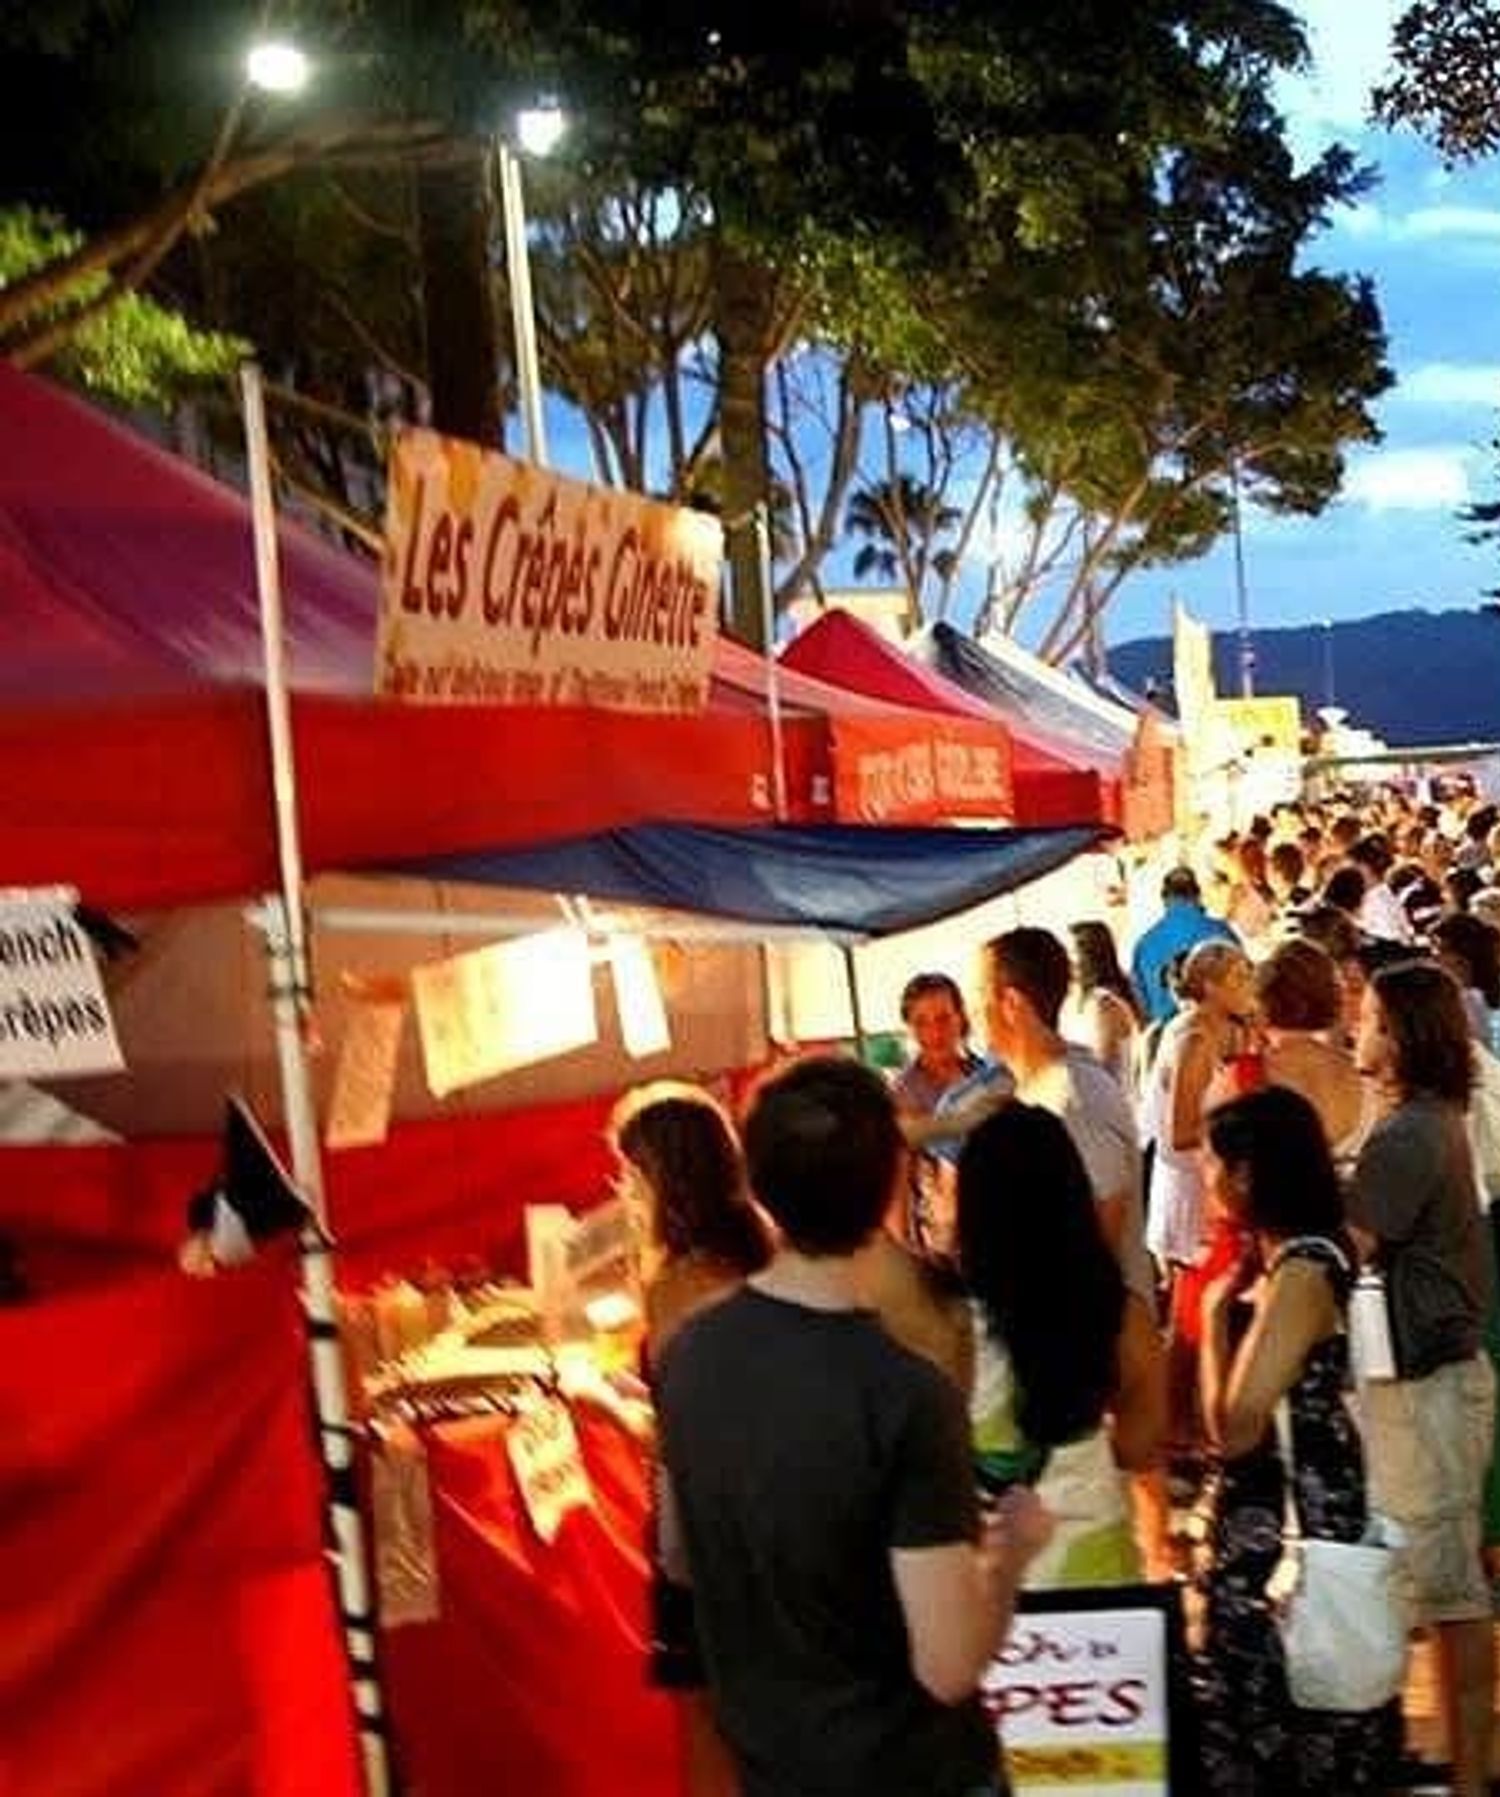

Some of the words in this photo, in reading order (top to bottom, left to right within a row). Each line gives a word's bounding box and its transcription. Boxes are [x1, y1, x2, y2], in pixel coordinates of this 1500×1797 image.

[402, 474, 474, 620] Les
[483, 488, 600, 657] Crêpes
[979, 1679, 1147, 1726] PES
